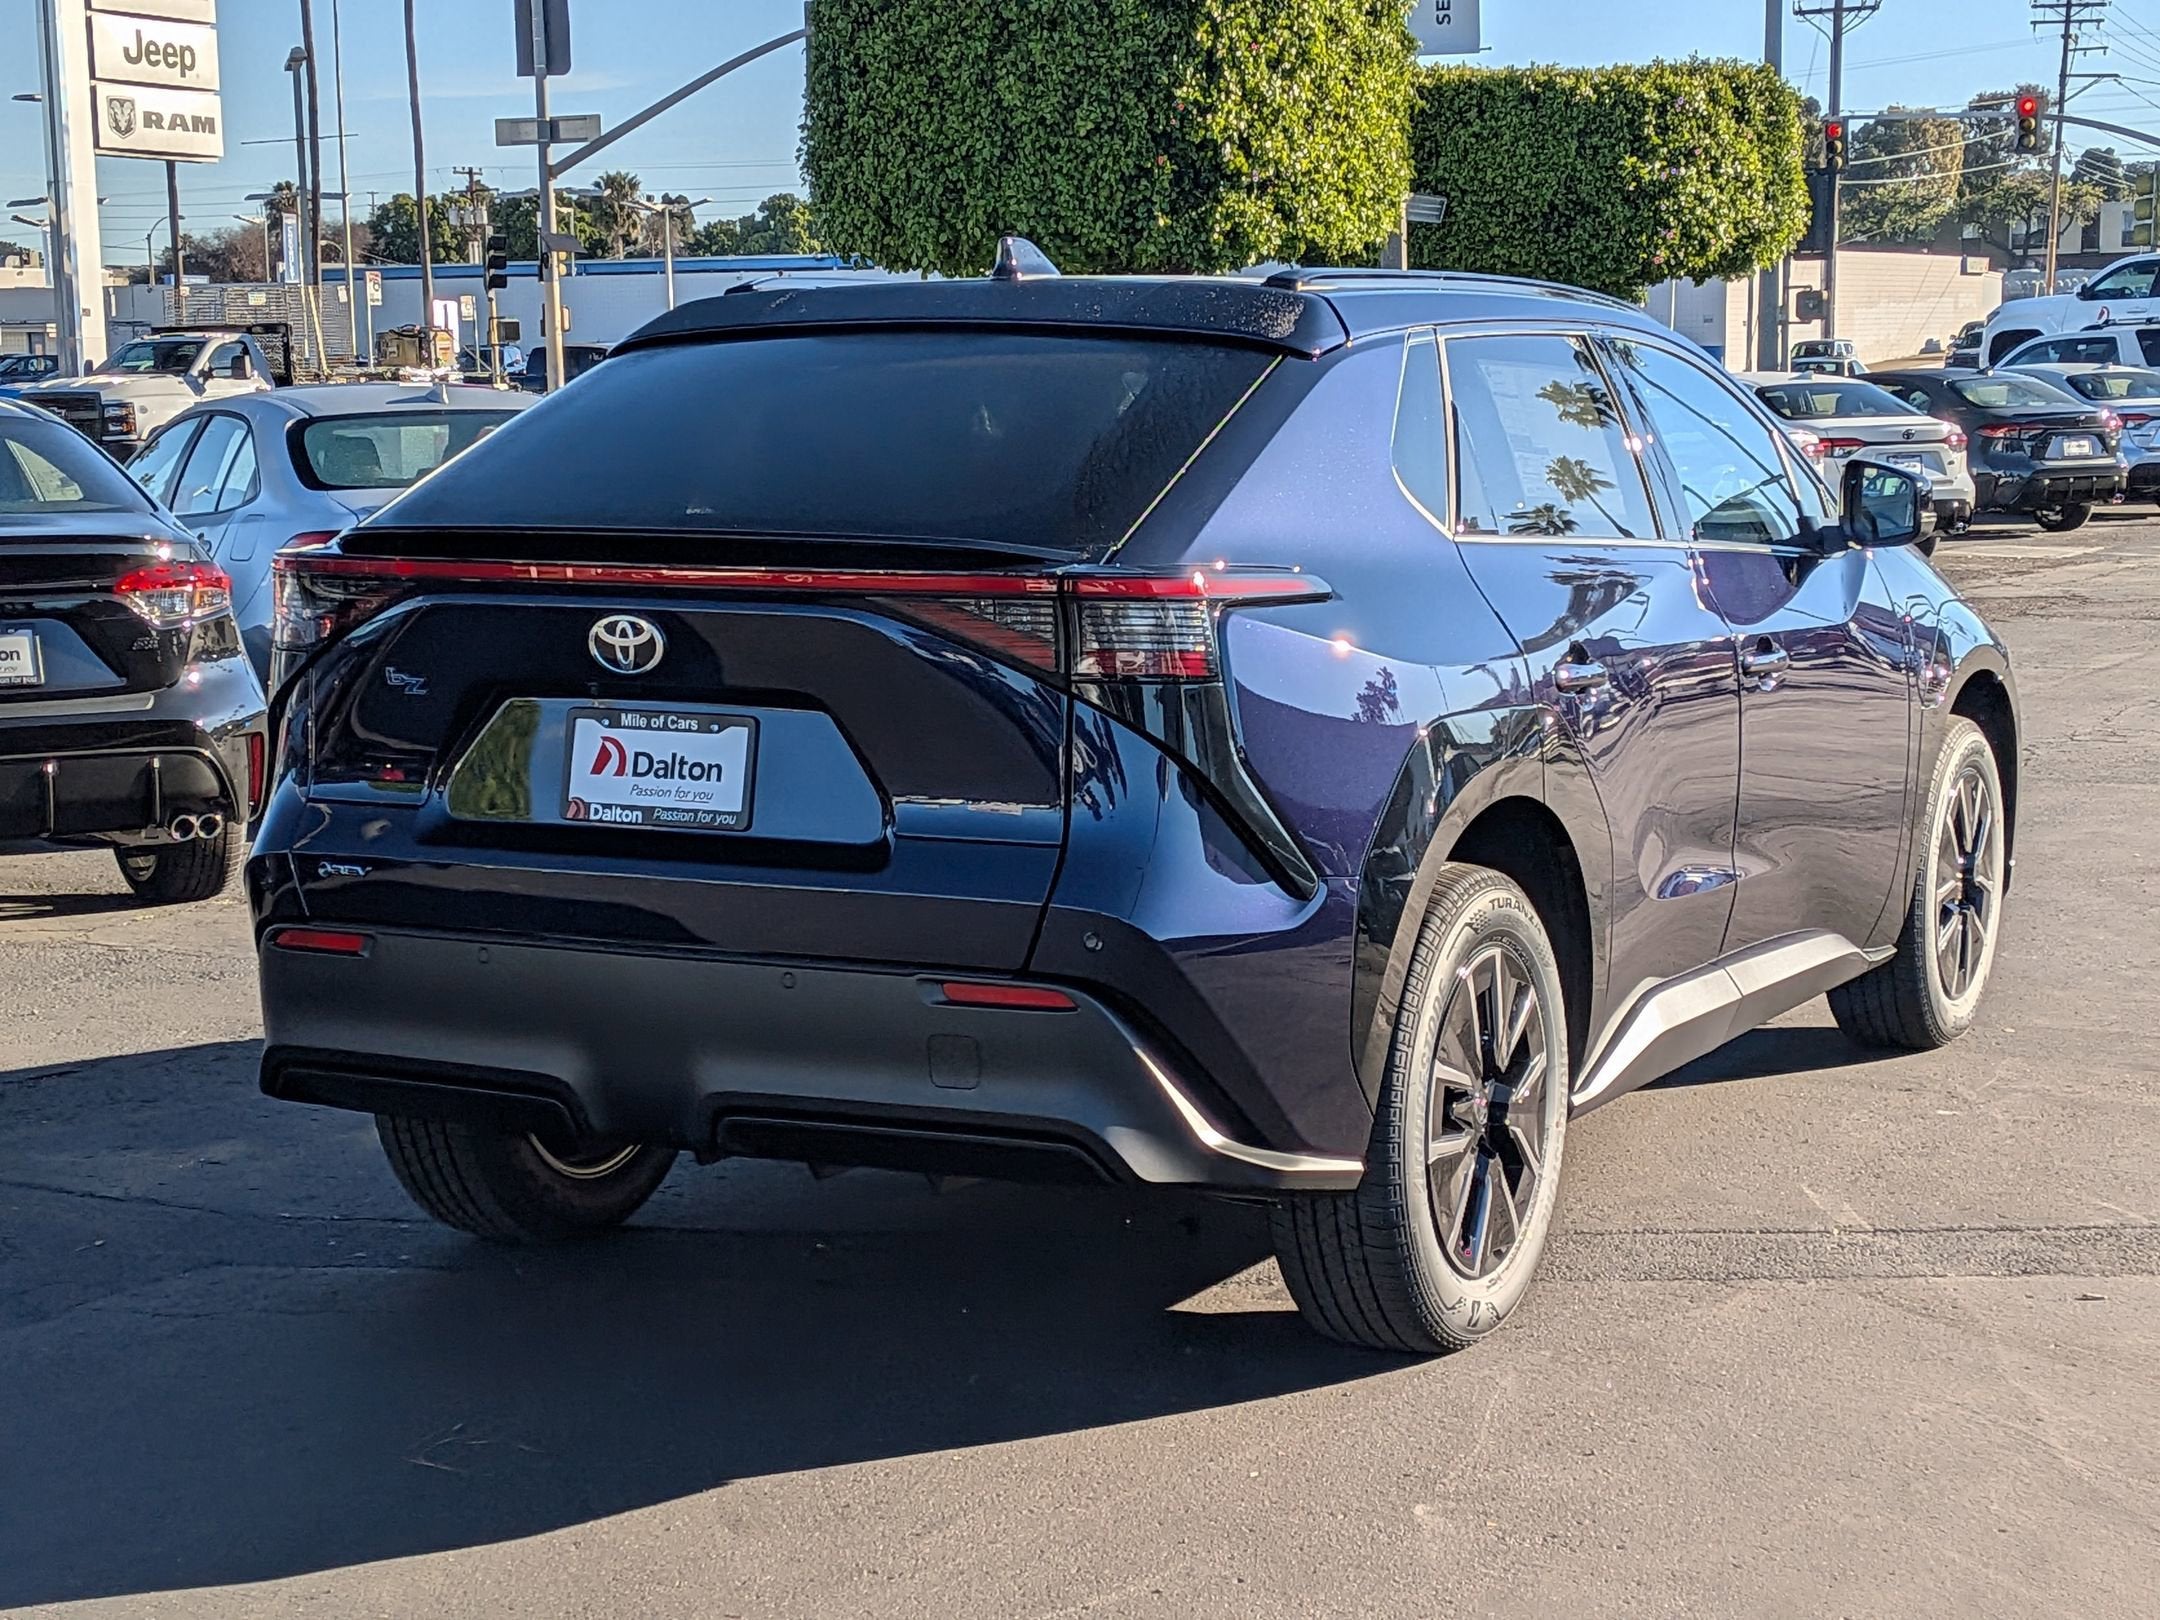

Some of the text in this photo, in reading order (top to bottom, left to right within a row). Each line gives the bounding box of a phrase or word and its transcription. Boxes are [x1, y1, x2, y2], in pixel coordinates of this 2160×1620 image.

[122, 28, 197, 79] Jeep
[142, 110, 217, 135] RAM
[620, 712, 698, 731] Mile of Cars
[631, 751, 723, 783] Dalton
[629, 783, 714, 801] Passion for you
[589, 803, 737, 826] Dalton Passion for you
